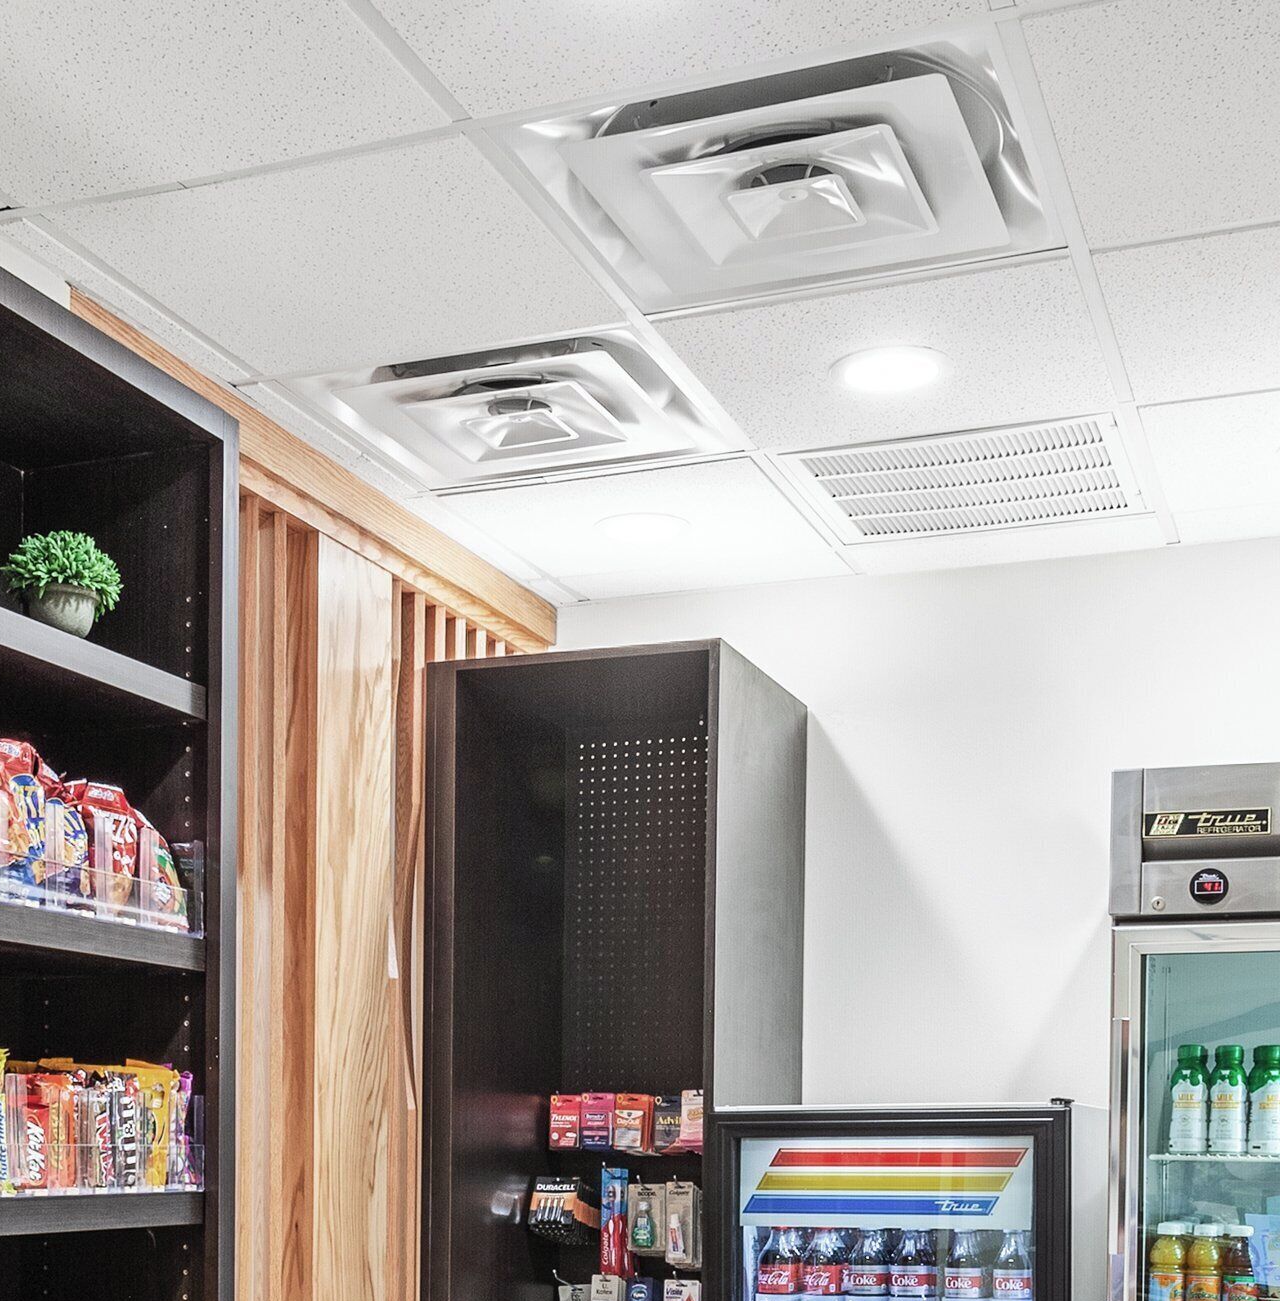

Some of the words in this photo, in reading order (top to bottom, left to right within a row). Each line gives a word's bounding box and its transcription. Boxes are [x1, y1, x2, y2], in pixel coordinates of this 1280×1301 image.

[1187, 811, 1260, 827] true
[1197, 824, 1261, 835] REFRIGERATOR
[536, 1183, 576, 1191] DURACELL
[935, 1199, 983, 1213] true
[601, 1231, 610, 1266] Colgate
[850, 1275, 877, 1287] Coke
[891, 1275, 918, 1287] Coke
[945, 1277, 972, 1289] Coke
[995, 1278, 1024, 1291] Coke
